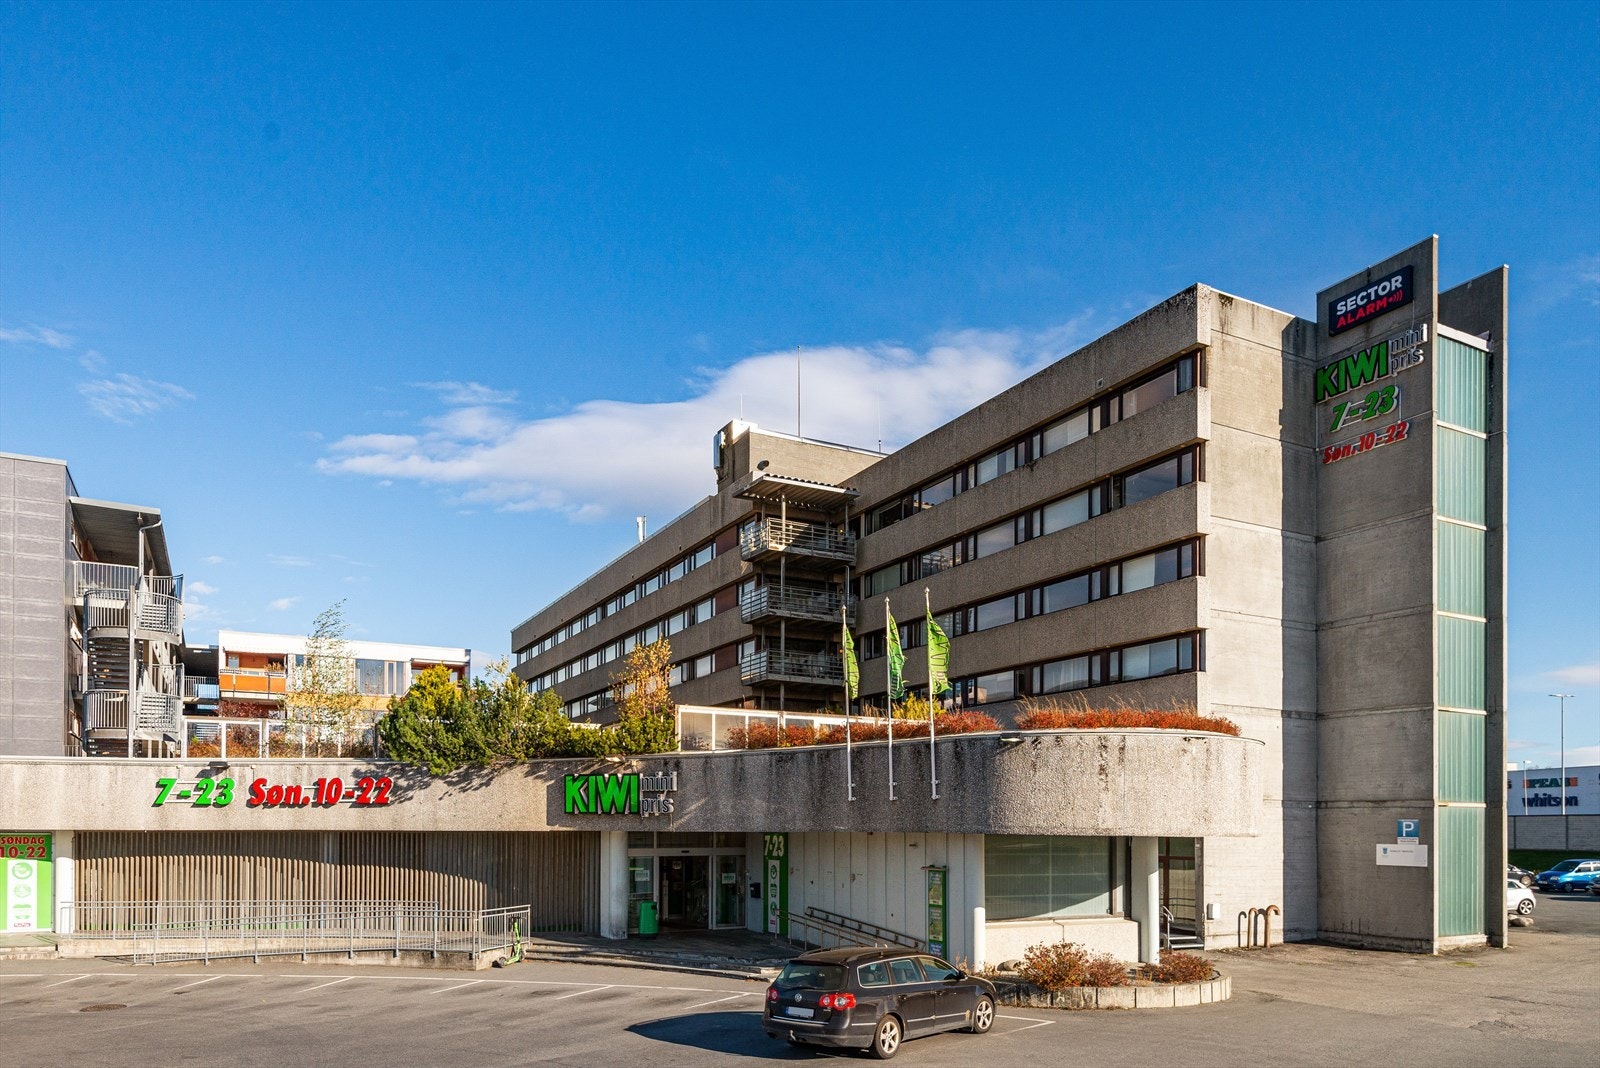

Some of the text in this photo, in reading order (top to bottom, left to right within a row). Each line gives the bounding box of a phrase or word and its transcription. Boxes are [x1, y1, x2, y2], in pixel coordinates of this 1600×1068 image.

[1336, 275, 1403, 316] SECTOR
[1336, 296, 1388, 328] ALARM
[1316, 323, 1428, 402] KIWI mini
[1390, 349, 1424, 376] pris
[564, 771, 678, 814] KIWI mini
[641, 793, 675, 817] pris
[0, 836, 45, 845] SØNDAG
[1402, 821, 1415, 837] P
[0, 846, 46, 859] 10-22
